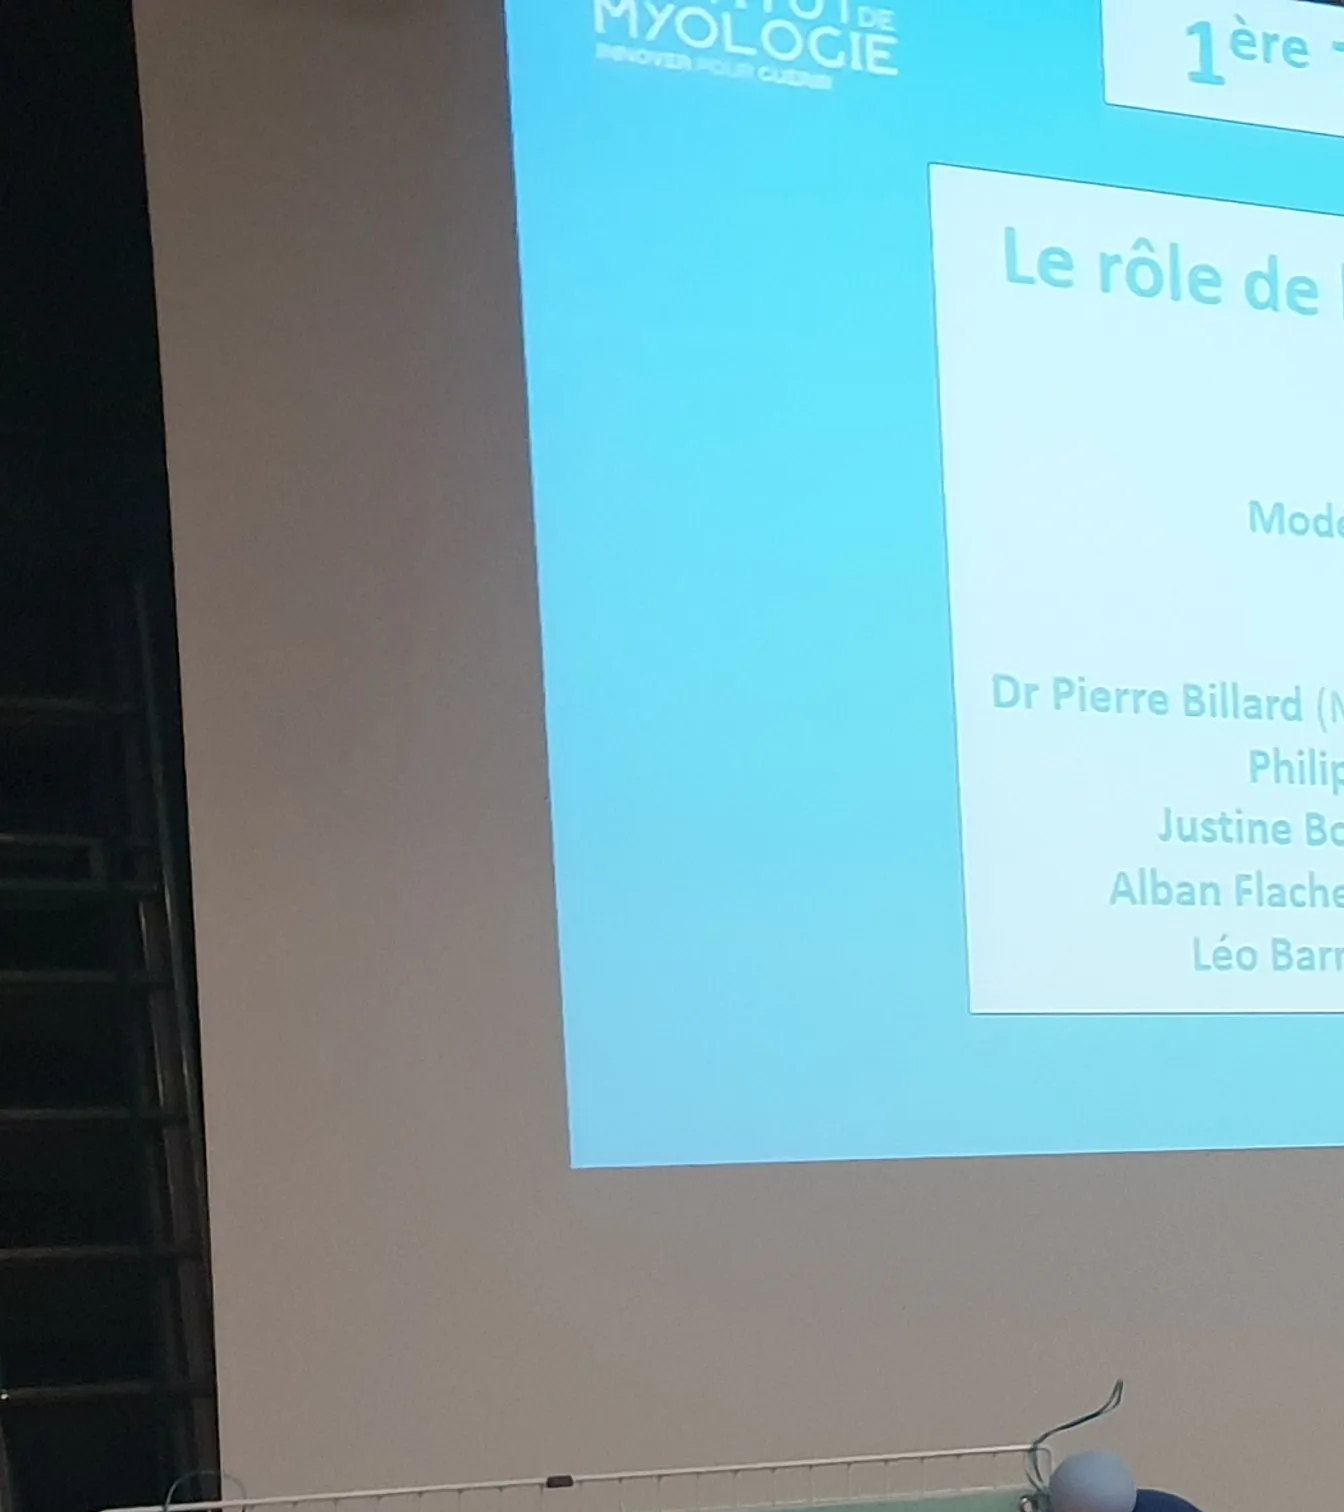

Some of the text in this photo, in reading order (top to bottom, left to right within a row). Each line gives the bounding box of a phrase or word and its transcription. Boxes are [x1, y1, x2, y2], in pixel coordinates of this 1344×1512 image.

[1184, 15, 1310, 88] 1ère
[1005, 226, 1075, 290] Le
[1101, 237, 1223, 305] rôle
[1245, 254, 1321, 317] de
[992, 673, 1041, 710] Dr
[1053, 676, 1170, 716] Pierre
[1183, 682, 1303, 722] Billard
[1158, 808, 1292, 844] Justine
[1109, 868, 1221, 906] Alban
[1193, 934, 1257, 973] Léo
